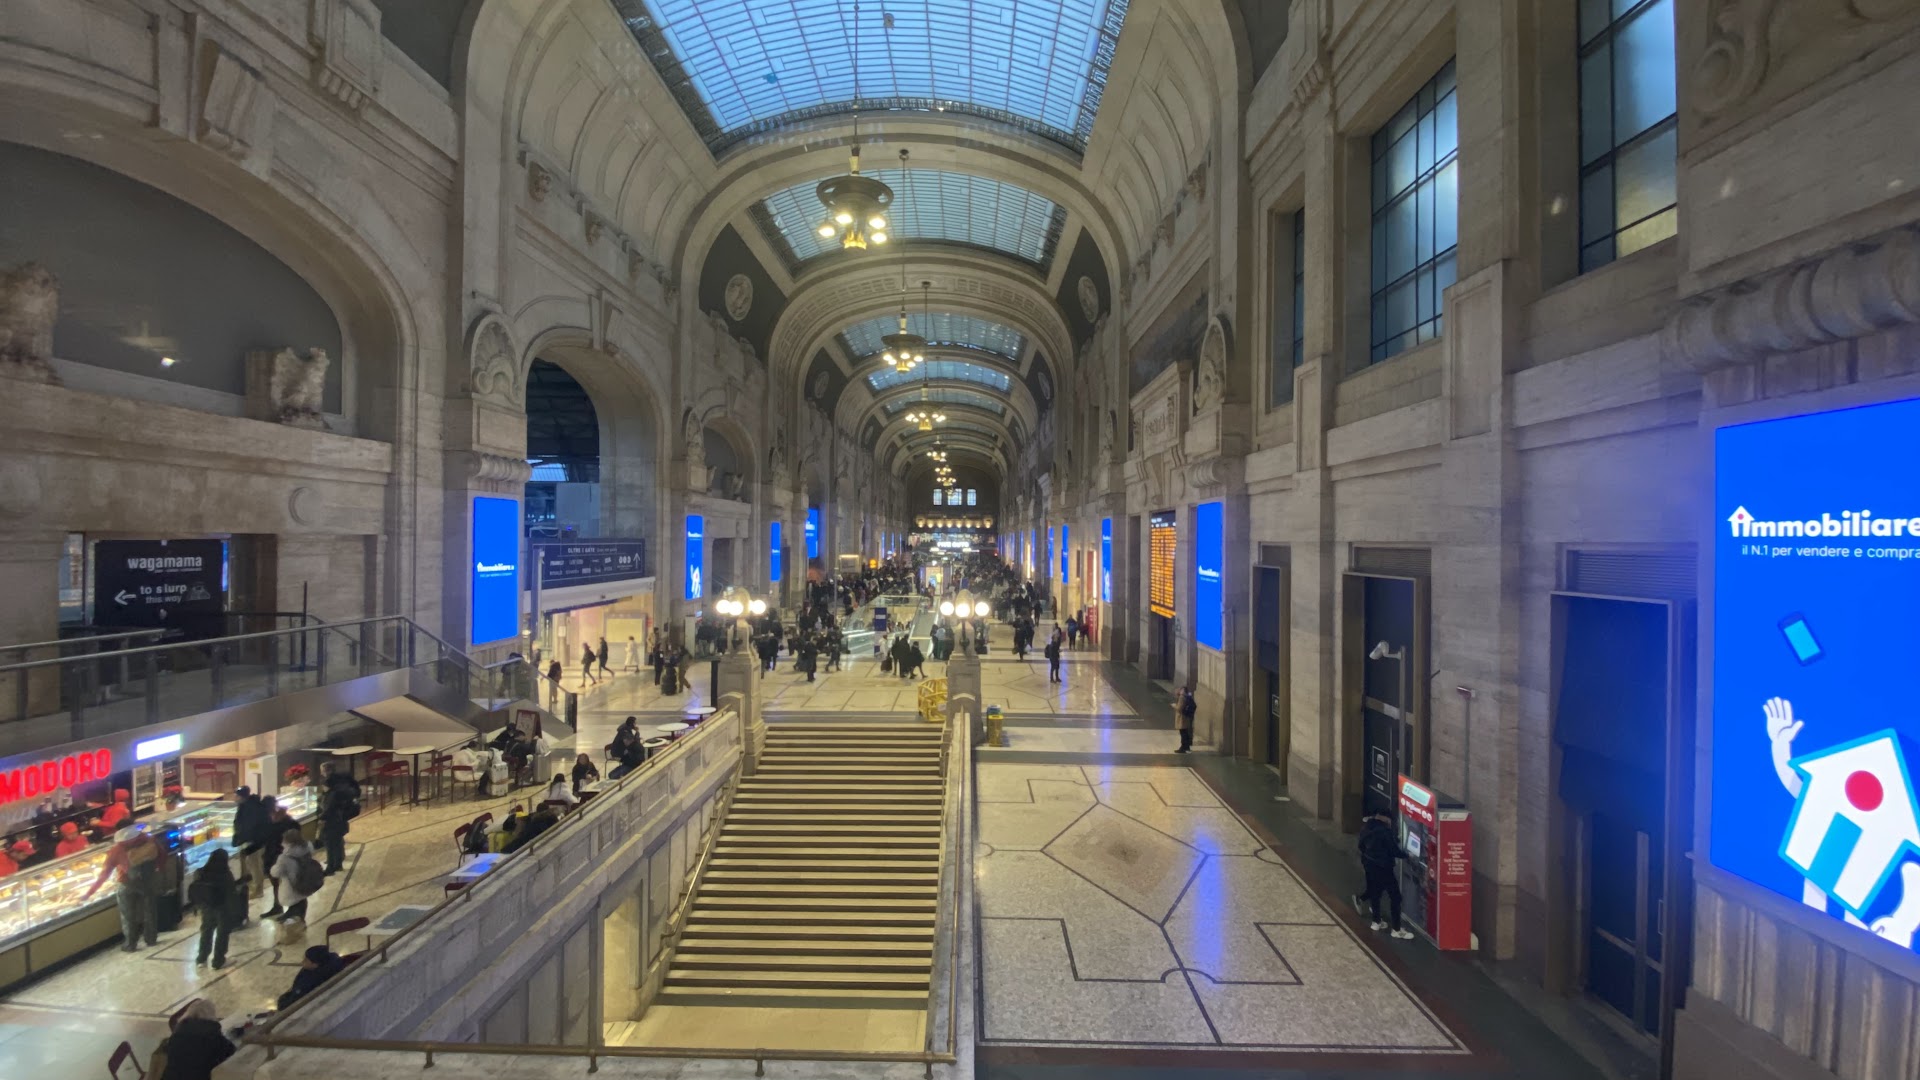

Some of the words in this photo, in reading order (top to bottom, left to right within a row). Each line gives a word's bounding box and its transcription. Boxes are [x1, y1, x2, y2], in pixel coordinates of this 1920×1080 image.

[1751, 545, 1768, 555] N.1
[1772, 547, 1793, 558] per
[1796, 545, 1850, 557] vendere
[1854, 548, 1863, 557] e
[127, 556, 203, 571] wagamama
[140, 586, 153, 594] to
[164, 595, 182, 604] way
